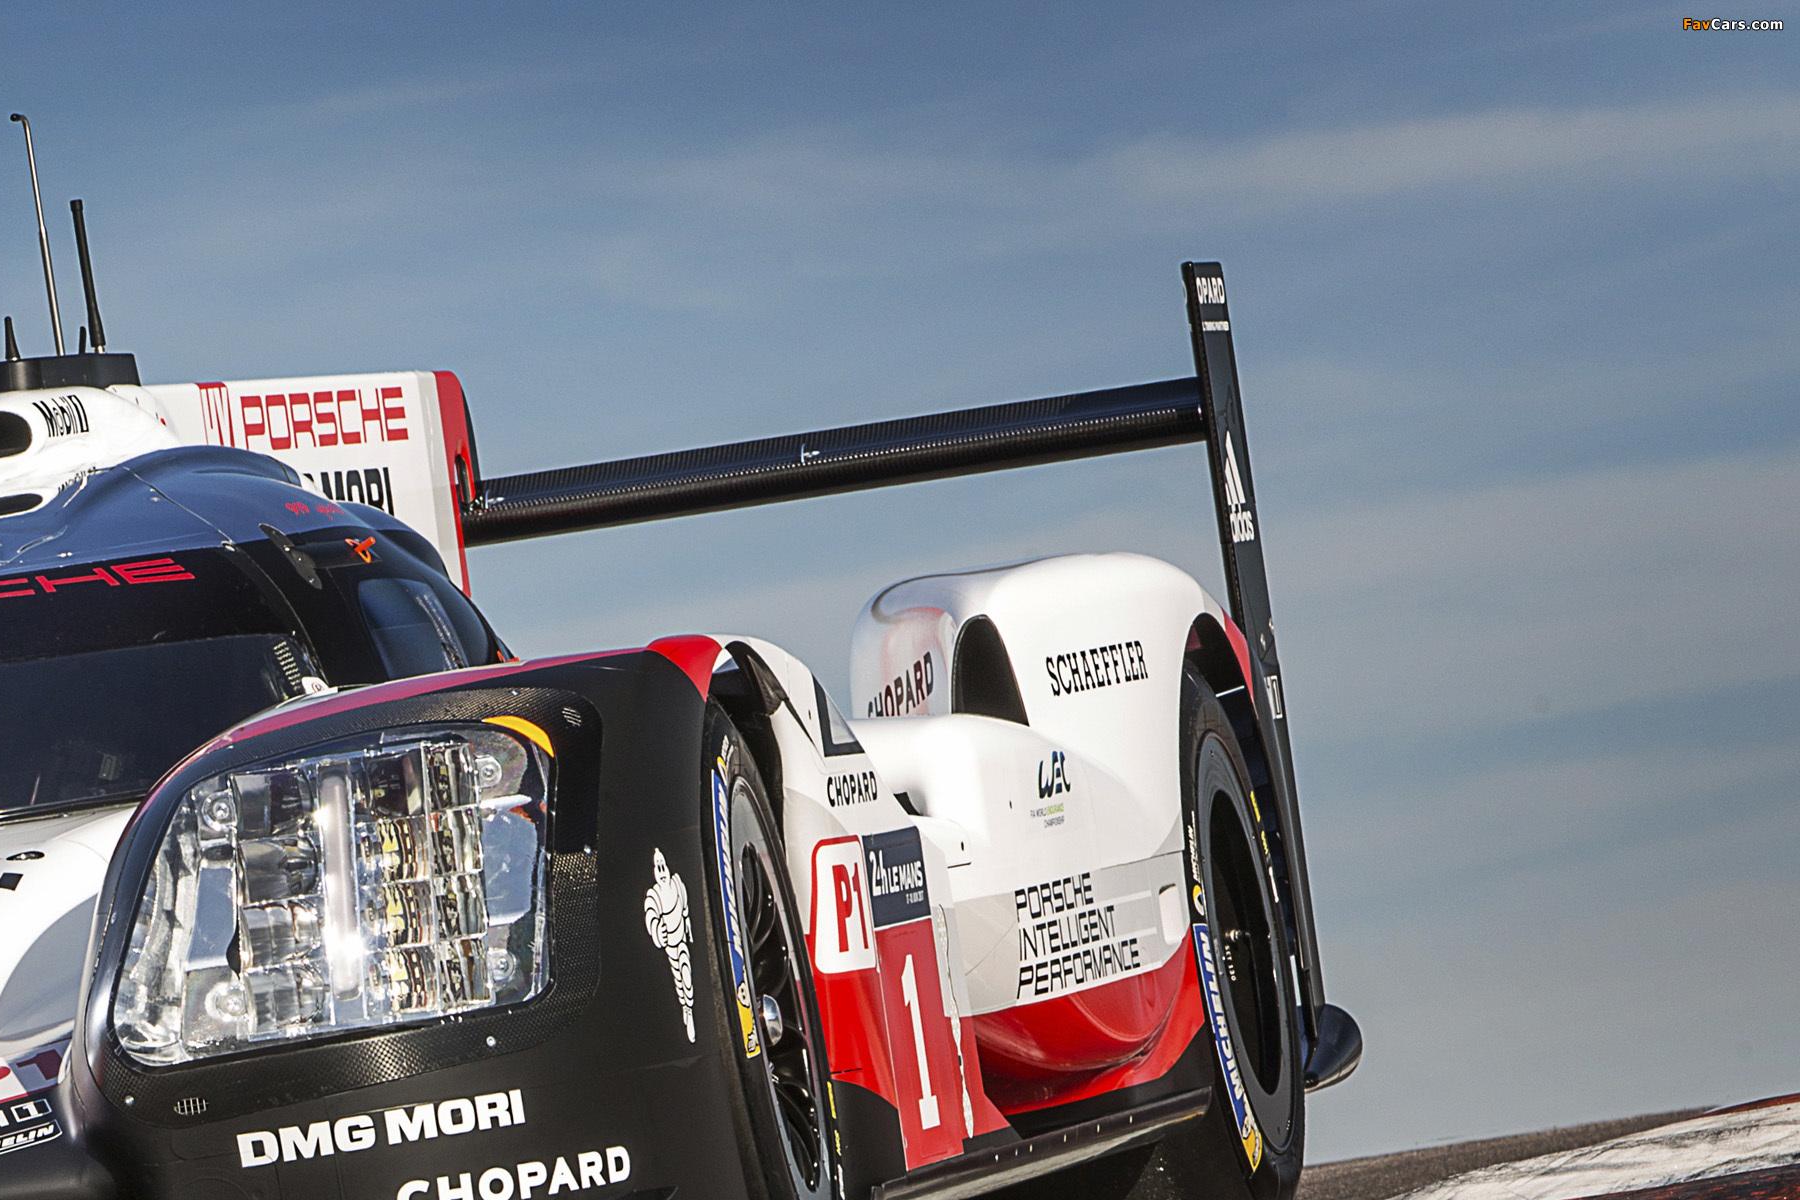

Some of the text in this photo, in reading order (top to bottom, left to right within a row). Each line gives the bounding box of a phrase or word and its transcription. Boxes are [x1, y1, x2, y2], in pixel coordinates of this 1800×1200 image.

[1195, 276, 1225, 304] OPARD
[240, 387, 409, 450] PORSCHE
[1046, 640, 1149, 697] SCHAEFFLER
[827, 771, 877, 807] CHOPARD
[887, 865, 900, 894] LE
[899, 860, 924, 892] MANS
[1014, 872, 1094, 923] PORSCHE
[832, 862, 869, 953] P1
[1019, 905, 1116, 962] INTELLIGENT
[1016, 938, 1141, 1000] PERFORMANCE
[901, 953, 942, 1131] 1
[1199, 931, 1244, 1101] MICHELIN
[236, 1089, 526, 1168] DMG MORI
